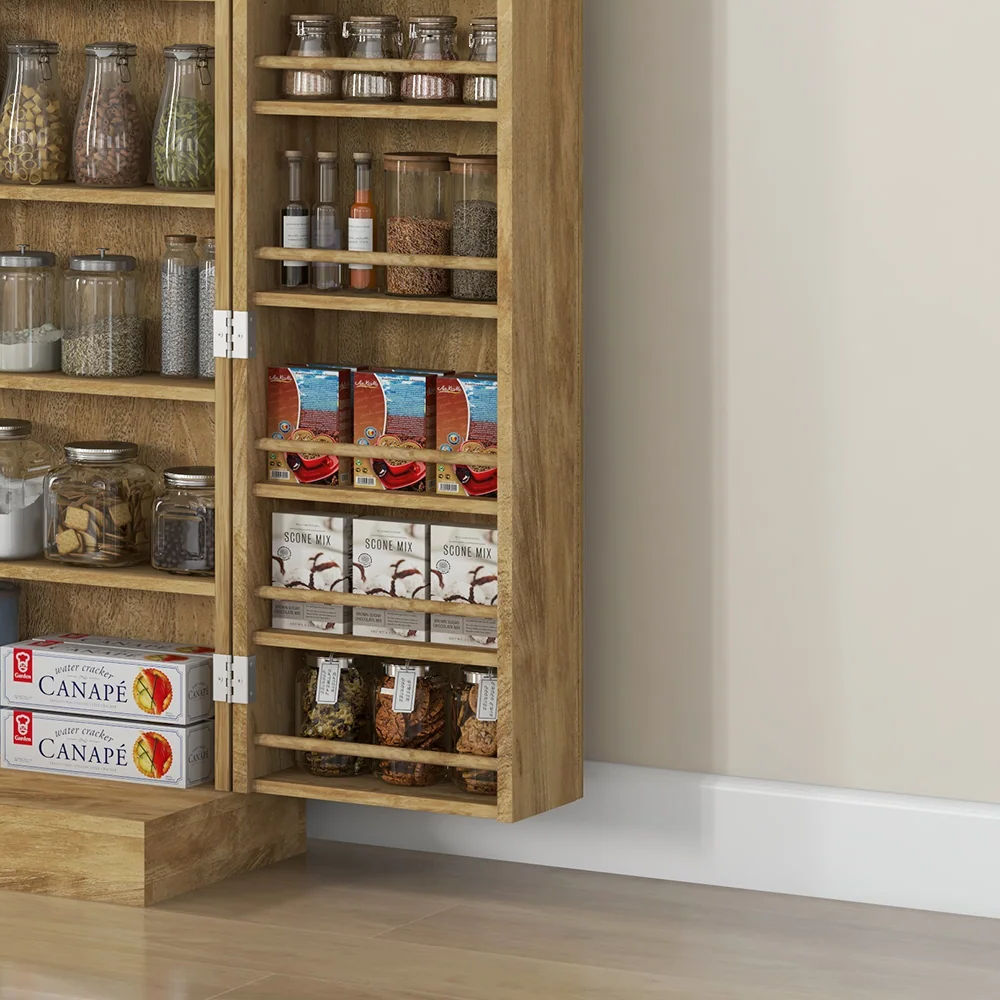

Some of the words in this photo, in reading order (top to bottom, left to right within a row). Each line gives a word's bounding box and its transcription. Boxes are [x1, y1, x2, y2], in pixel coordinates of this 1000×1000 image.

[284, 532, 312, 545] SCONE
[315, 534, 331, 546] MIX
[365, 538, 394, 552] SCONE
[396, 541, 413, 553] MIX
[443, 544, 472, 558] SCONE
[475, 547, 492, 559] MIX
[14, 672, 32, 680] Garden
[55, 663, 79, 675] water
[82, 664, 115, 681] cracker
[39, 675, 128, 703] CANAPÉ
[14, 734, 32, 743] Garden
[55, 726, 79, 738] water
[82, 728, 115, 743] cracker
[39, 738, 128, 767] CANAPÉ
